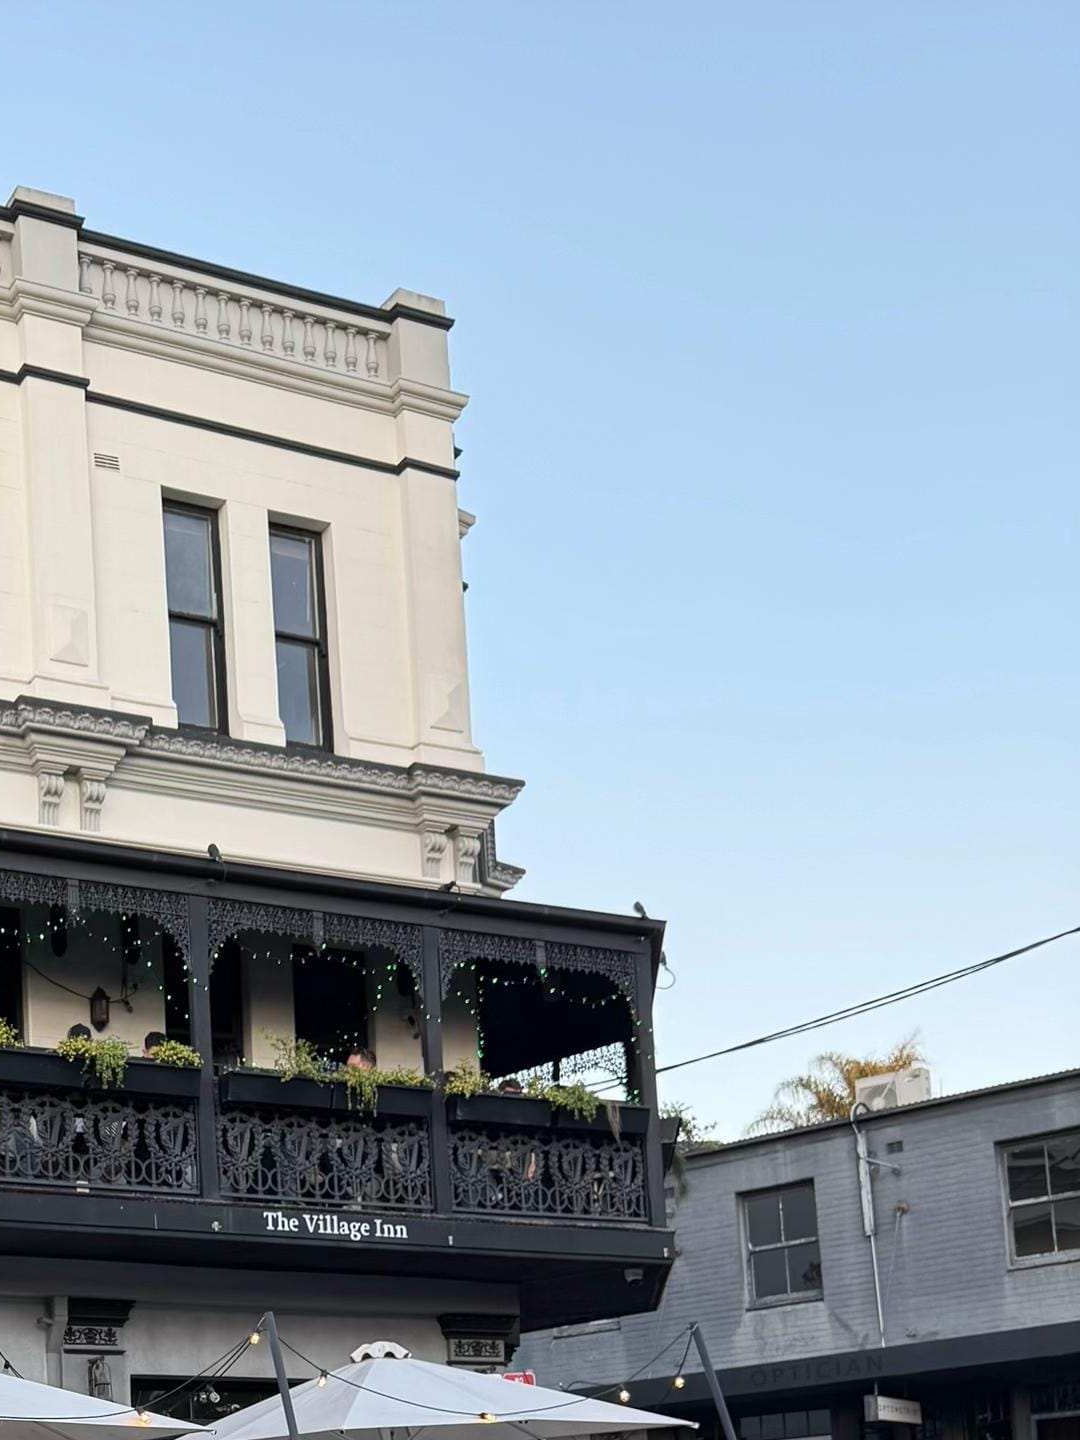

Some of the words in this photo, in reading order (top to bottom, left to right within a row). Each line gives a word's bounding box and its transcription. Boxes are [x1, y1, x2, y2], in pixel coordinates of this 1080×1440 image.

[263, 1211, 299, 1232] The
[303, 1213, 370, 1241] Village
[374, 1218, 409, 1239] Inn
[750, 1355, 883, 1387] OPTICIAN
